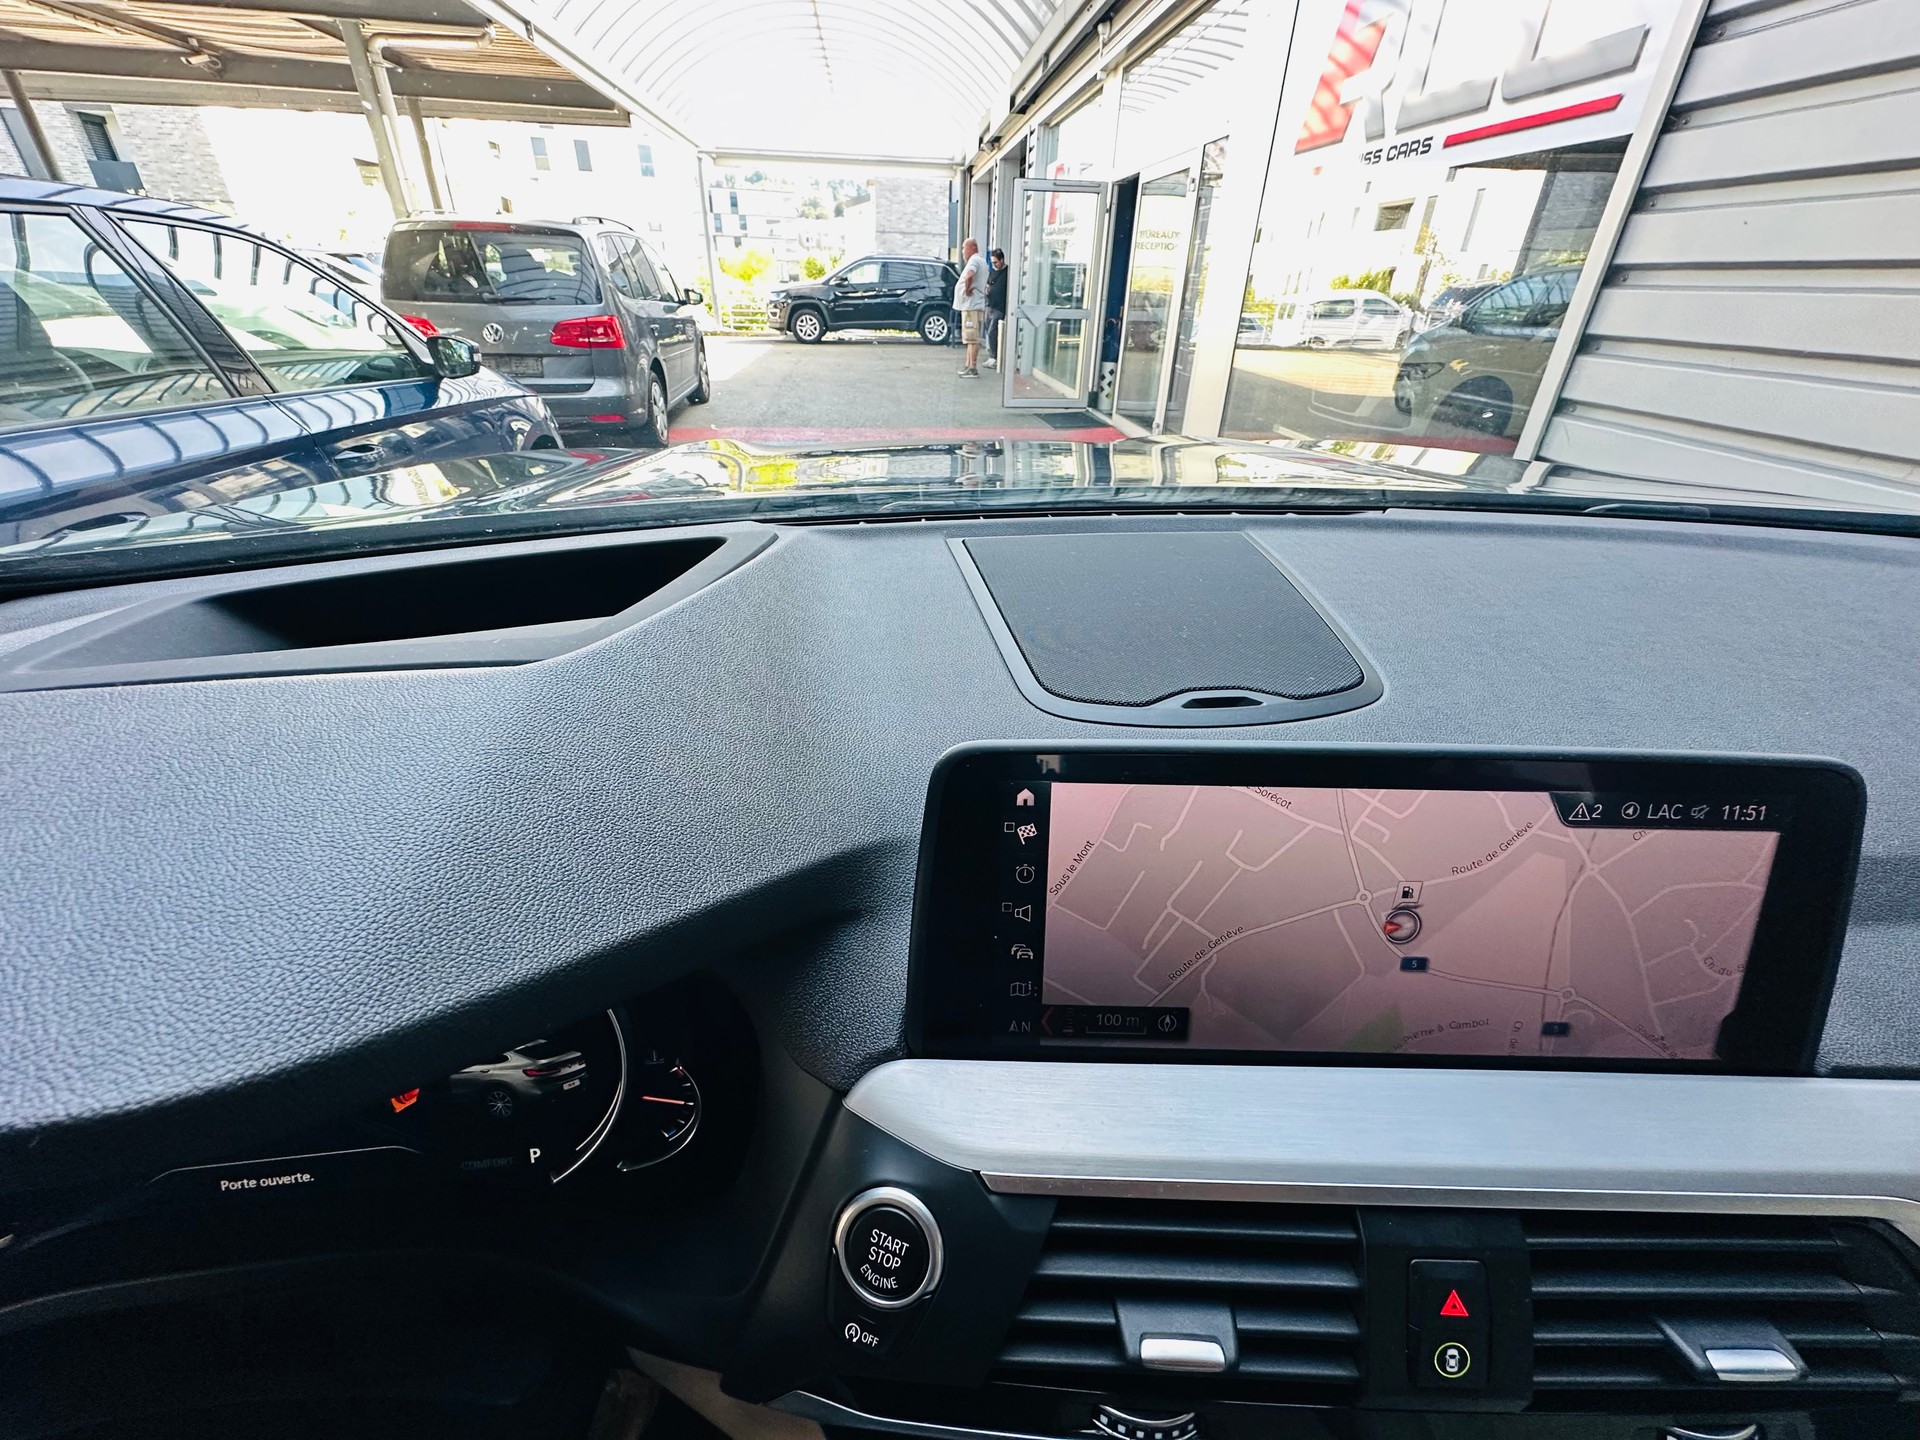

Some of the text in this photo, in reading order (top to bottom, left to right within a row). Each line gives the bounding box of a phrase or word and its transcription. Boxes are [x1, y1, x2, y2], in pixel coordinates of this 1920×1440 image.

[1387, 136, 1434, 162] CARS
[1136, 242, 1177, 251] RECEPTIO
[1255, 786, 1292, 810] Sorécot
[1592, 804, 1603, 818] 2
[1647, 804, 1683, 819] LAC
[1722, 805, 1767, 821] 11:51
[1451, 821, 1534, 875] Route de Genève
[1049, 840, 1096, 896] Sous le Mont
[1168, 926, 1244, 981] Route de Genève
[1411, 960, 1418, 969] 5
[1096, 1013, 1139, 1027] 100 m
[461, 1157, 513, 1170] COMFORT
[529, 1147, 542, 1164] P
[220, 1172, 315, 1191] Porte ouverte.
[870, 1228, 910, 1256] START
[868, 1246, 901, 1270] STOP
[860, 1264, 898, 1289] ENGINE
[861, 1332, 880, 1348] OFF
